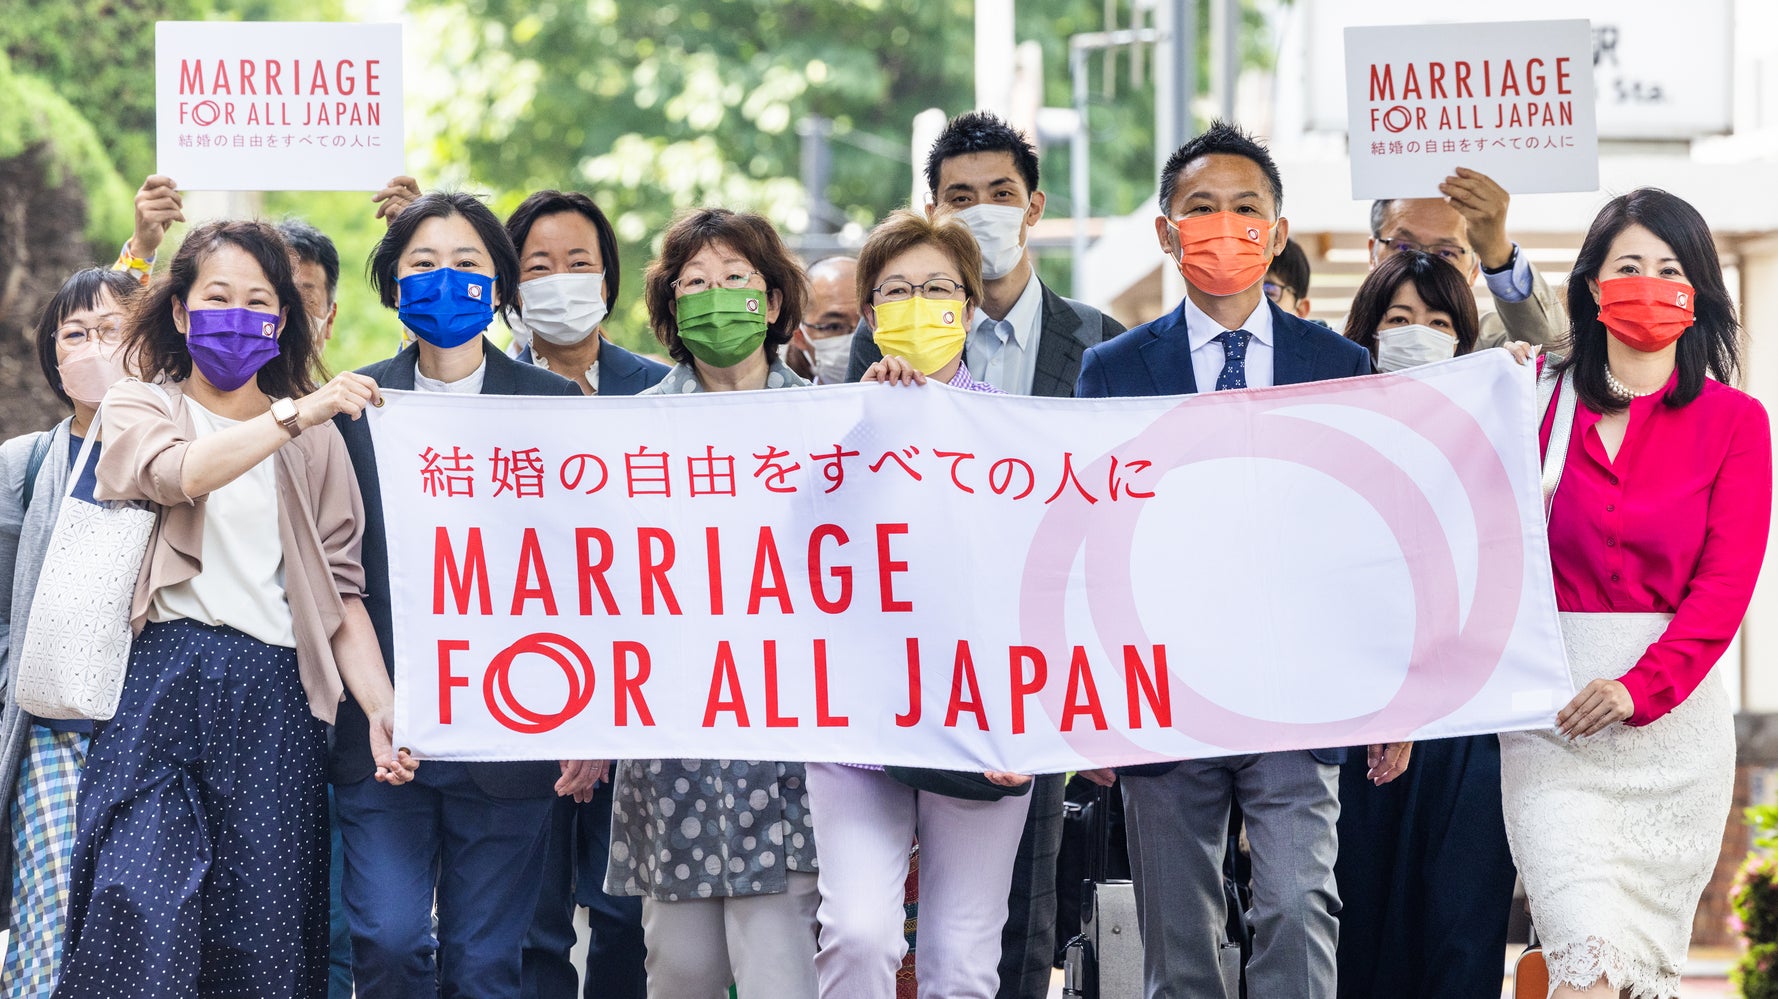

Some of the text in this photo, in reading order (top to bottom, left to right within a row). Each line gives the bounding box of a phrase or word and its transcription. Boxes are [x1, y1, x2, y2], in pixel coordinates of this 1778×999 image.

[179, 59, 381, 96] MARRIAGE
[1369, 57, 1571, 101] MARRIAGE
[179, 100, 381, 126] FOR ALL JAPAN
[1371, 101, 1573, 133] FOR ALL JAPAN
[179, 133, 381, 148] 結婚の自由をすべての人に
[1371, 136, 1575, 155] 結婚の自由をすべての人に
[418, 444, 1155, 505] 結婚の自由をすべての人に
[433, 523, 913, 616] MARRIAGE
[437, 632, 1173, 735] FOR ALL JAPAN
